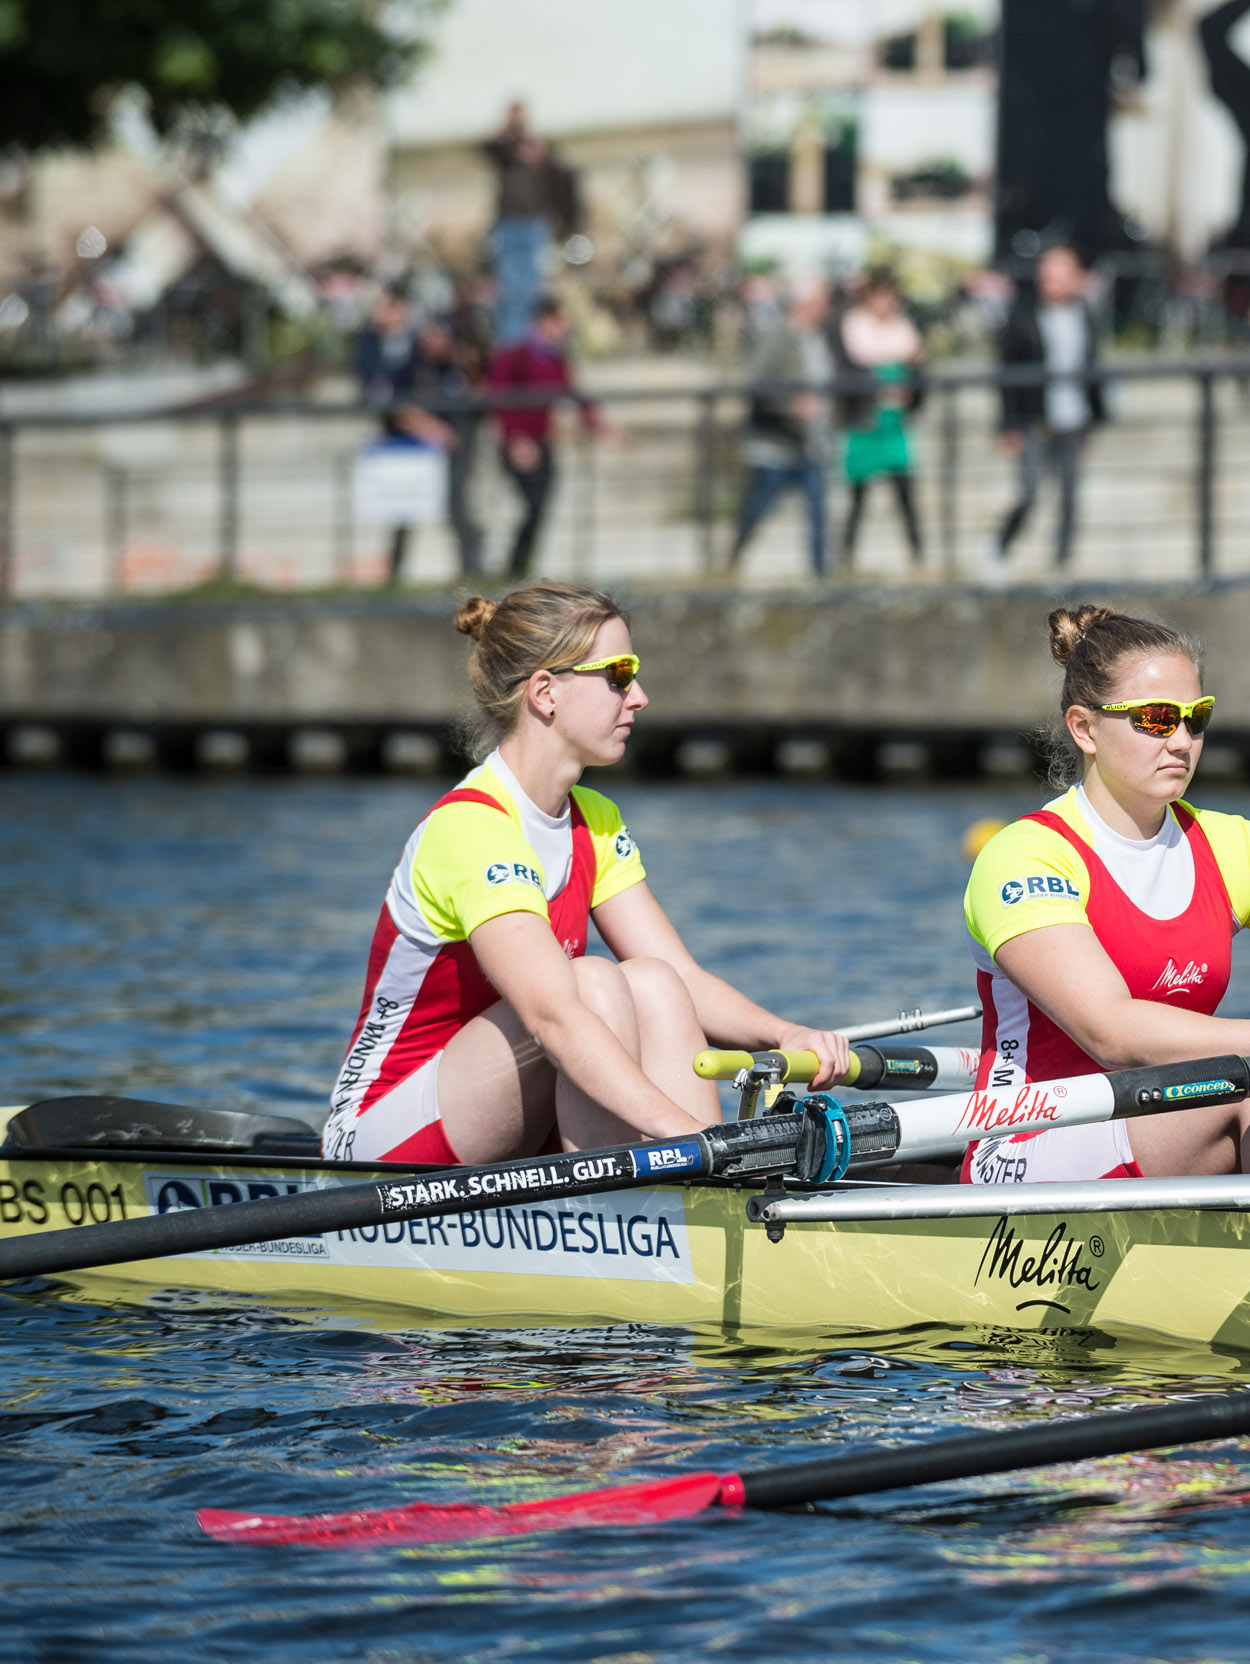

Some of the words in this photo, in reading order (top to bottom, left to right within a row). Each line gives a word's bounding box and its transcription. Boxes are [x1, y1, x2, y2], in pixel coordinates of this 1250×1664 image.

[513, 863, 542, 886] RB
[1026, 876, 1080, 897] RBL
[1000, 1038, 1020, 1064] 8+
[647, 1147, 688, 1167] RBL
[389, 1178, 466, 1208] STARK.
[469, 1165, 570, 1197] SCHNELL.
[572, 1157, 622, 1182] GUT.
[60, 1181, 128, 1226] 001
[337, 1208, 681, 1259] DER-BUNDESLIGA
[218, 1241, 327, 1255] UDER-BUNDESLIGA
